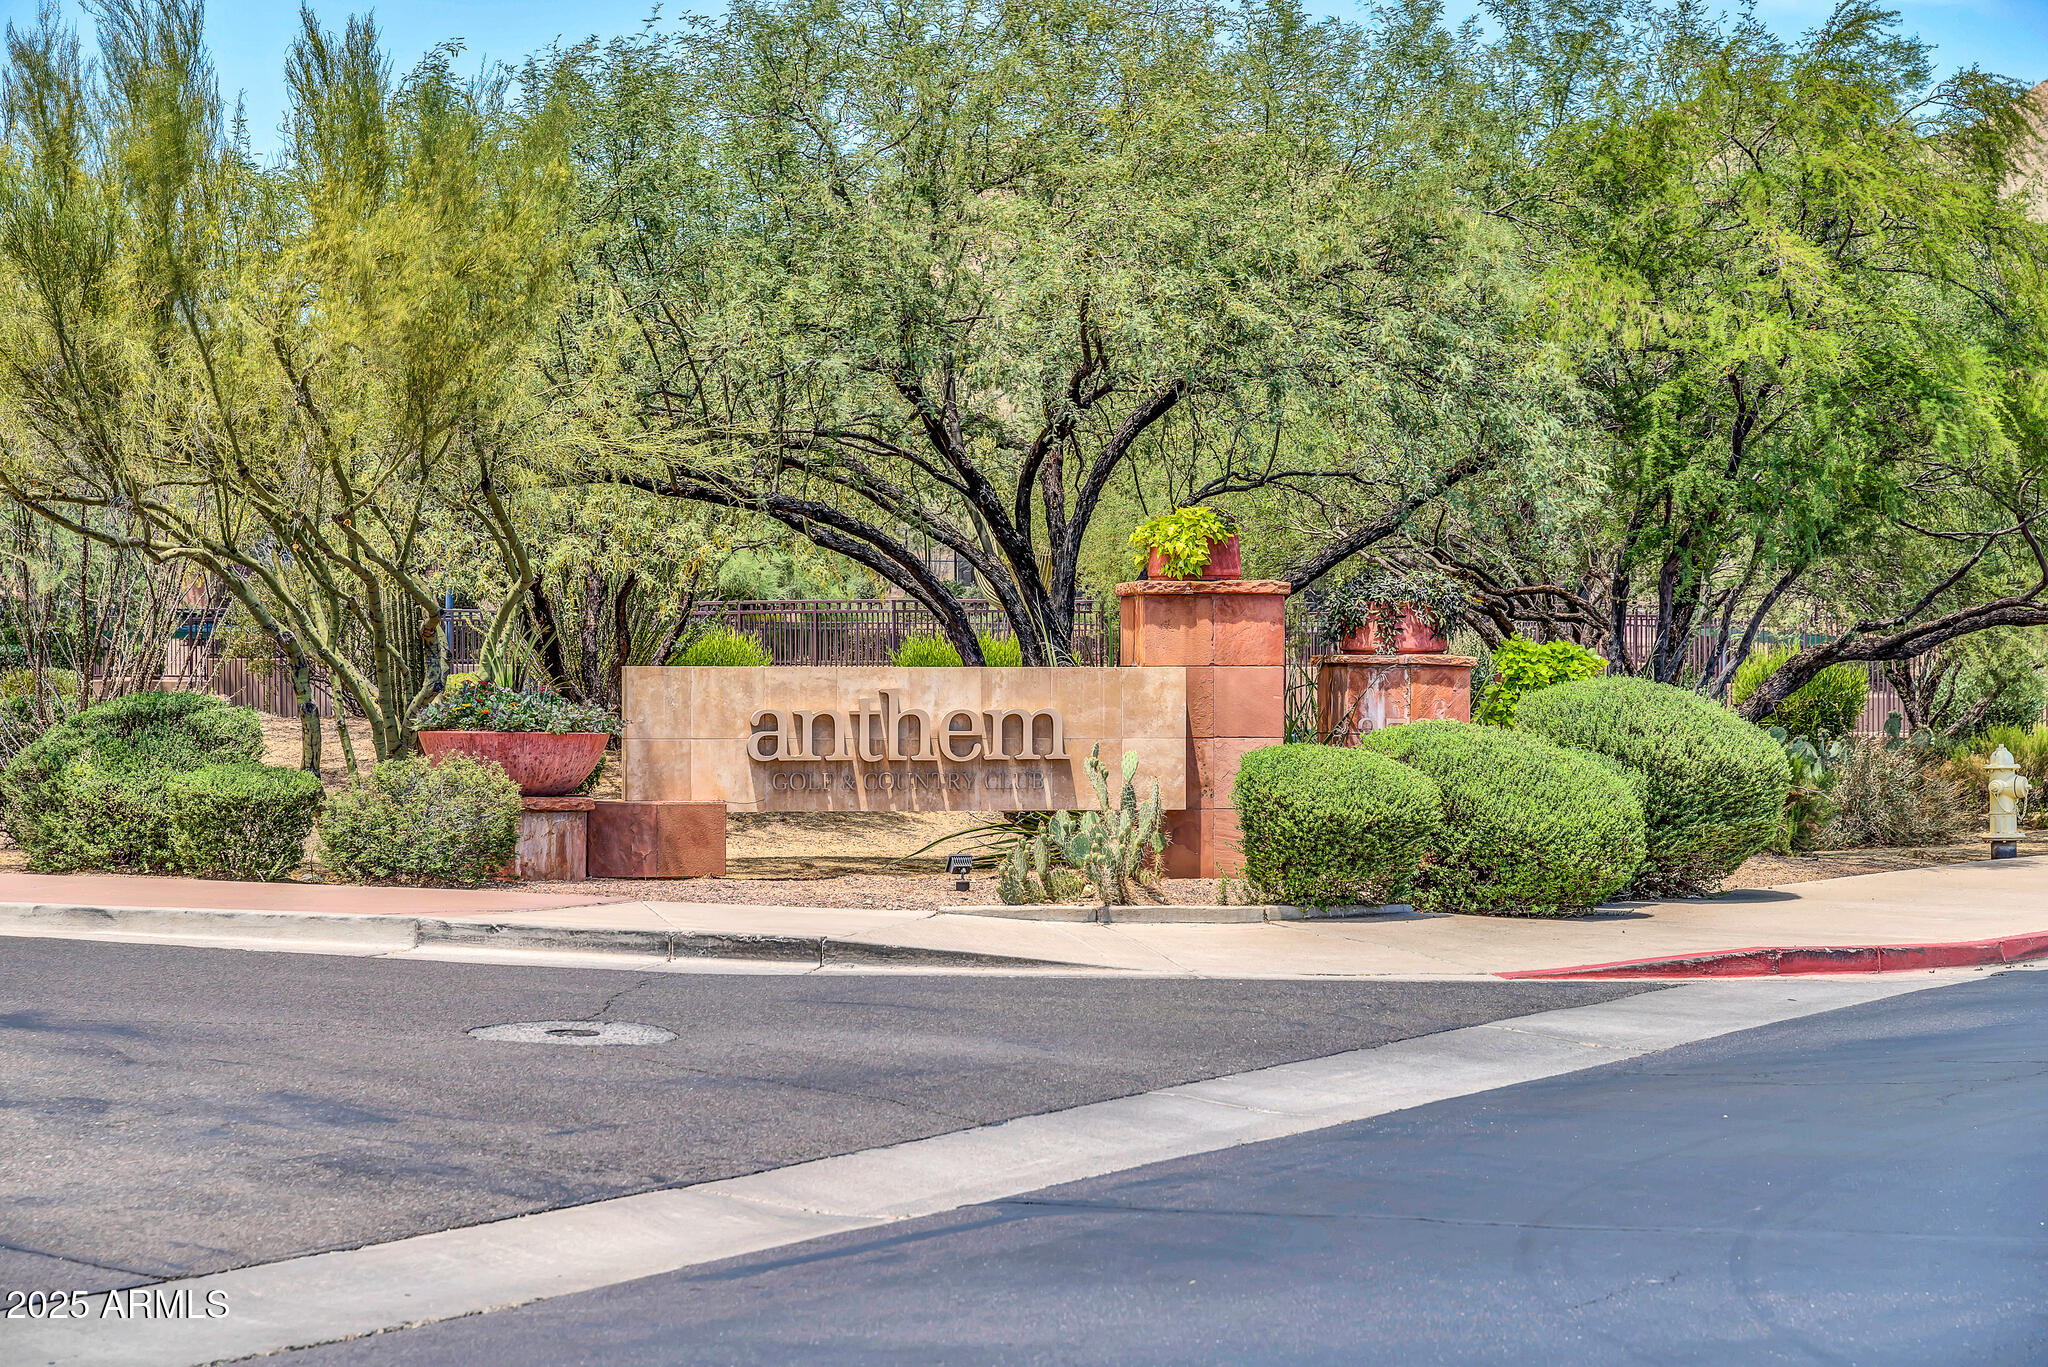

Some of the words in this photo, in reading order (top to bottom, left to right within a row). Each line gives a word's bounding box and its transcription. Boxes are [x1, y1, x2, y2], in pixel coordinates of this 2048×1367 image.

[747, 688, 1071, 762] anthem
[772, 772, 835, 791] GOLF
[842, 772, 856, 791] &
[863, 772, 977, 791] COUNTRY
[984, 772, 1045, 791] CLUB
